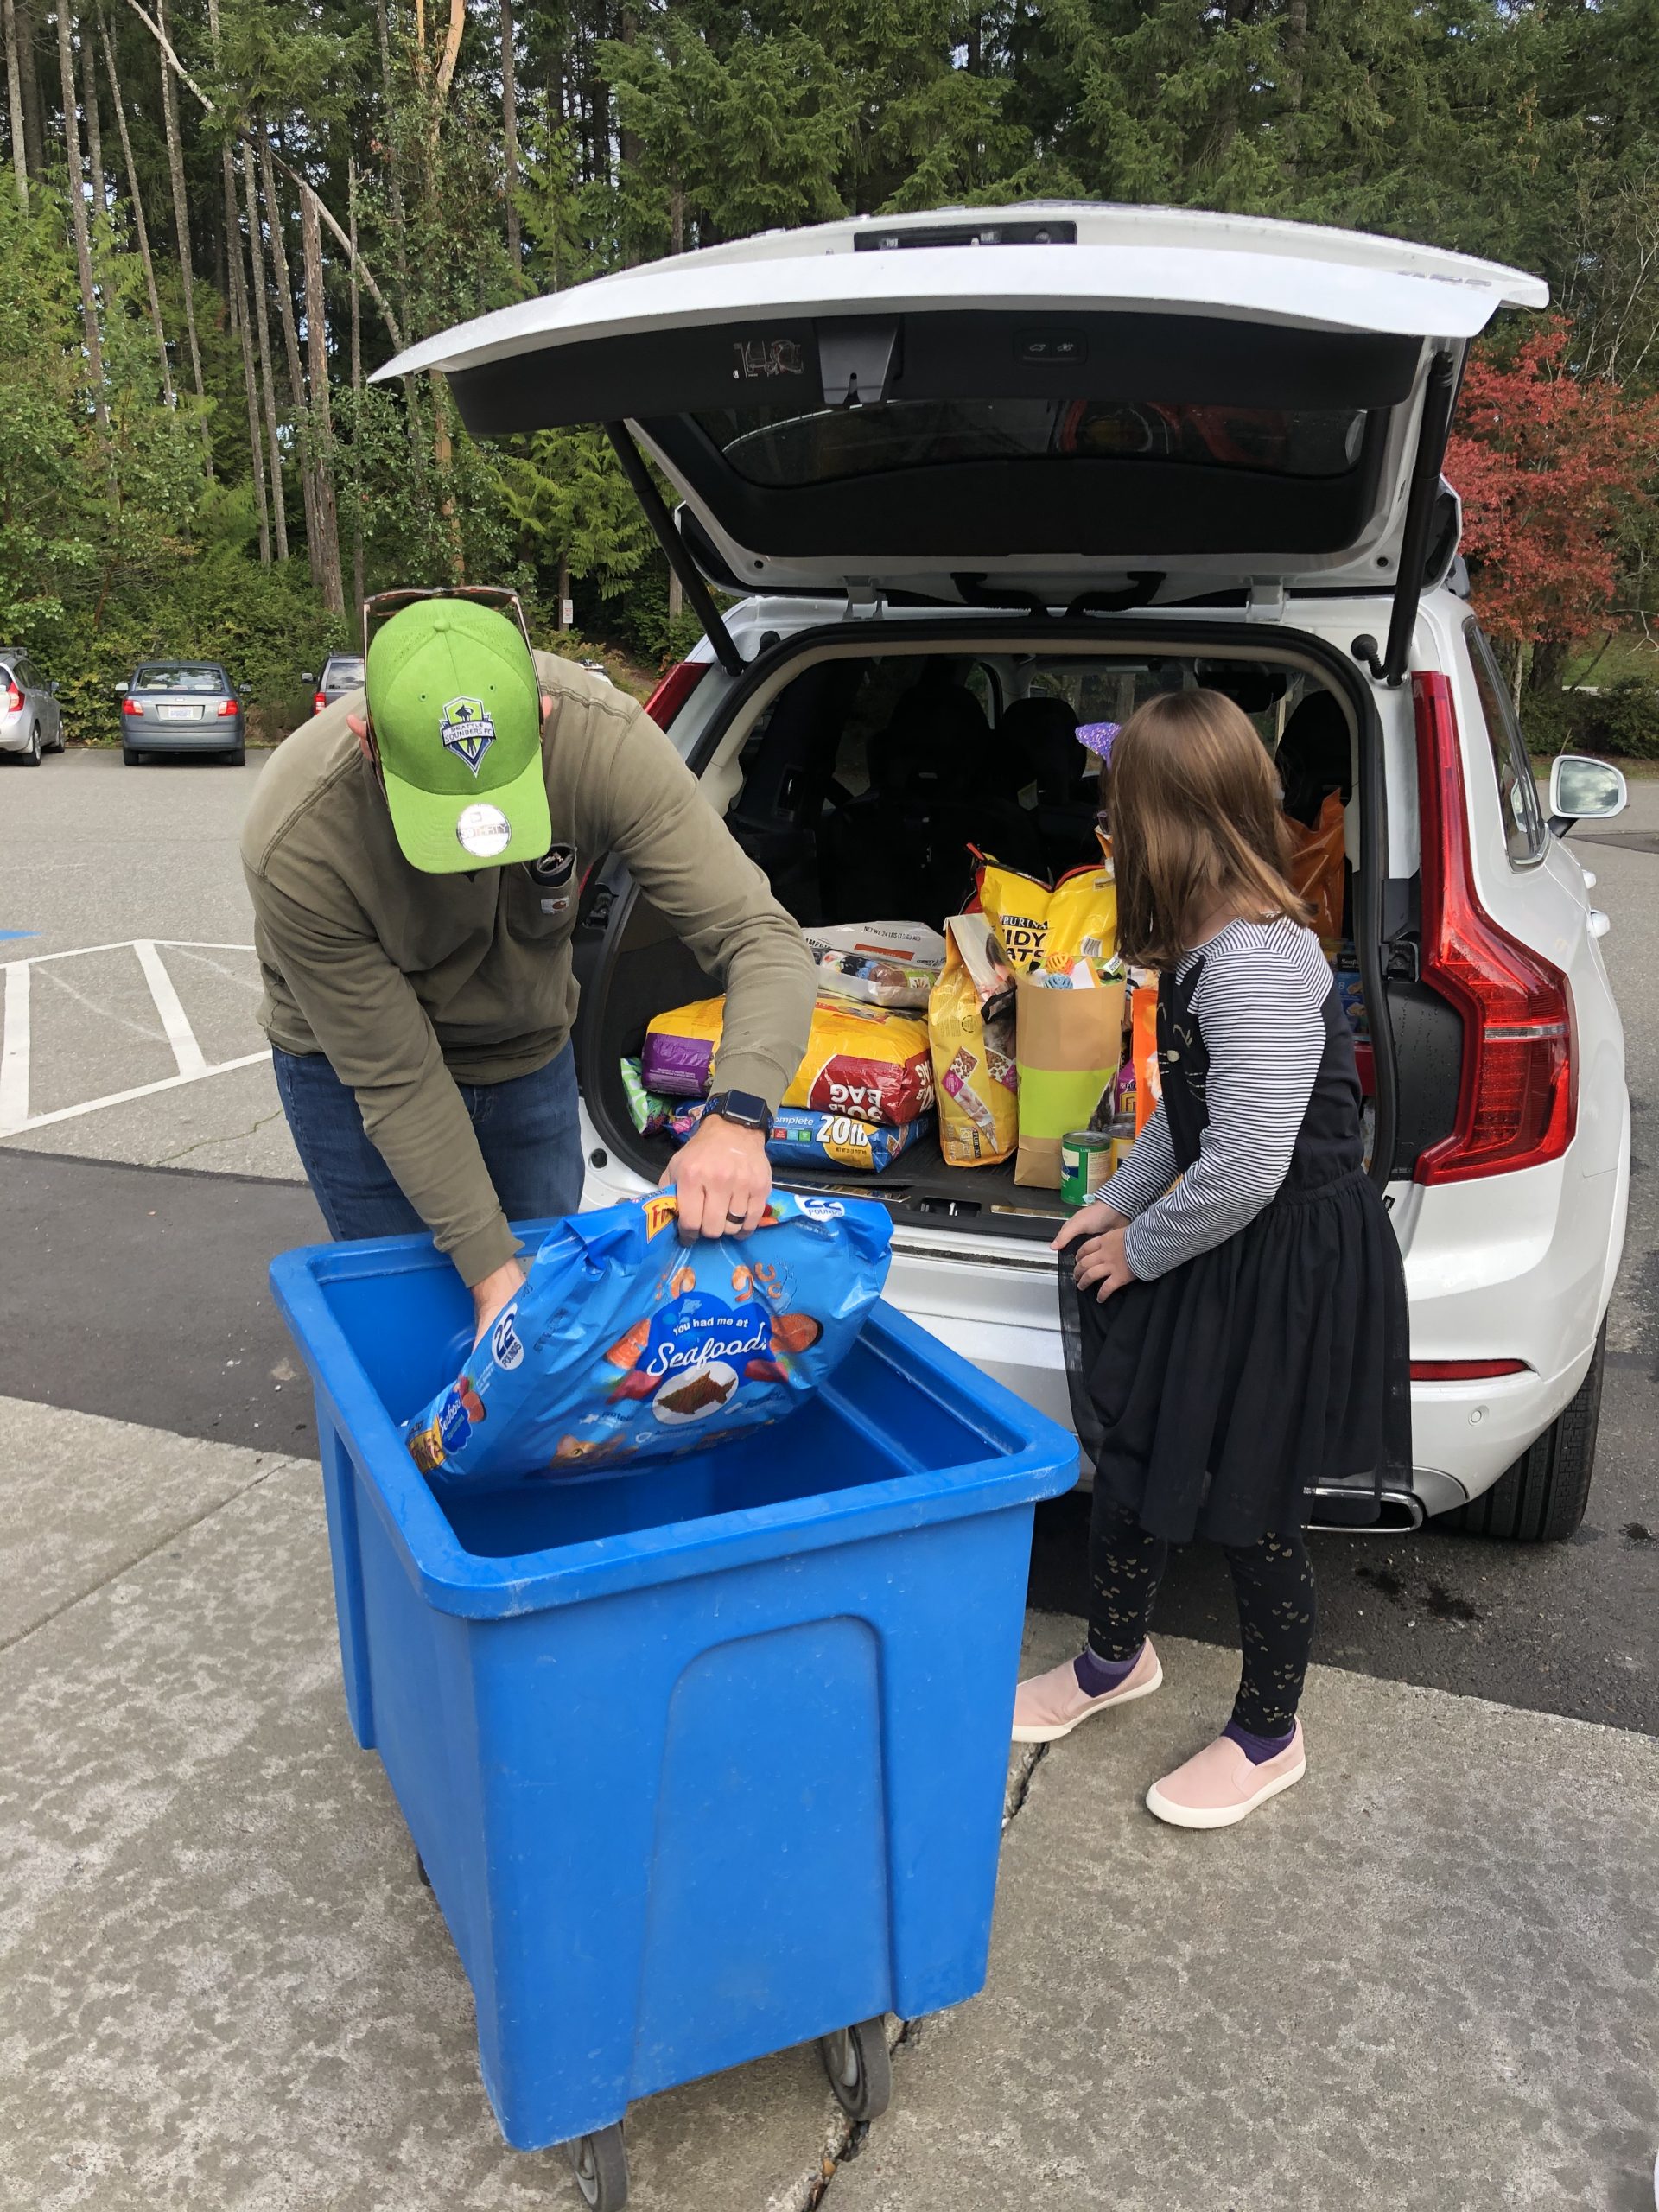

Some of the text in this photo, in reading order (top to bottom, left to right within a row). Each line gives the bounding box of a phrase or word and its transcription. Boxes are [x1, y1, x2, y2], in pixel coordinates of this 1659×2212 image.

[445, 728, 493, 743] SOUNDERS FC
[451, 722, 483, 733] SEATTLE
[1003, 916, 1047, 930] PURINA
[1002, 928, 1046, 948] IDY
[1006, 947, 1045, 963] ATS
[830, 1084, 883, 1109] BAG
[673, 1317, 749, 1336] You had me at
[493, 1313, 516, 1361] 22
[501, 1341, 522, 1369] POUNDS
